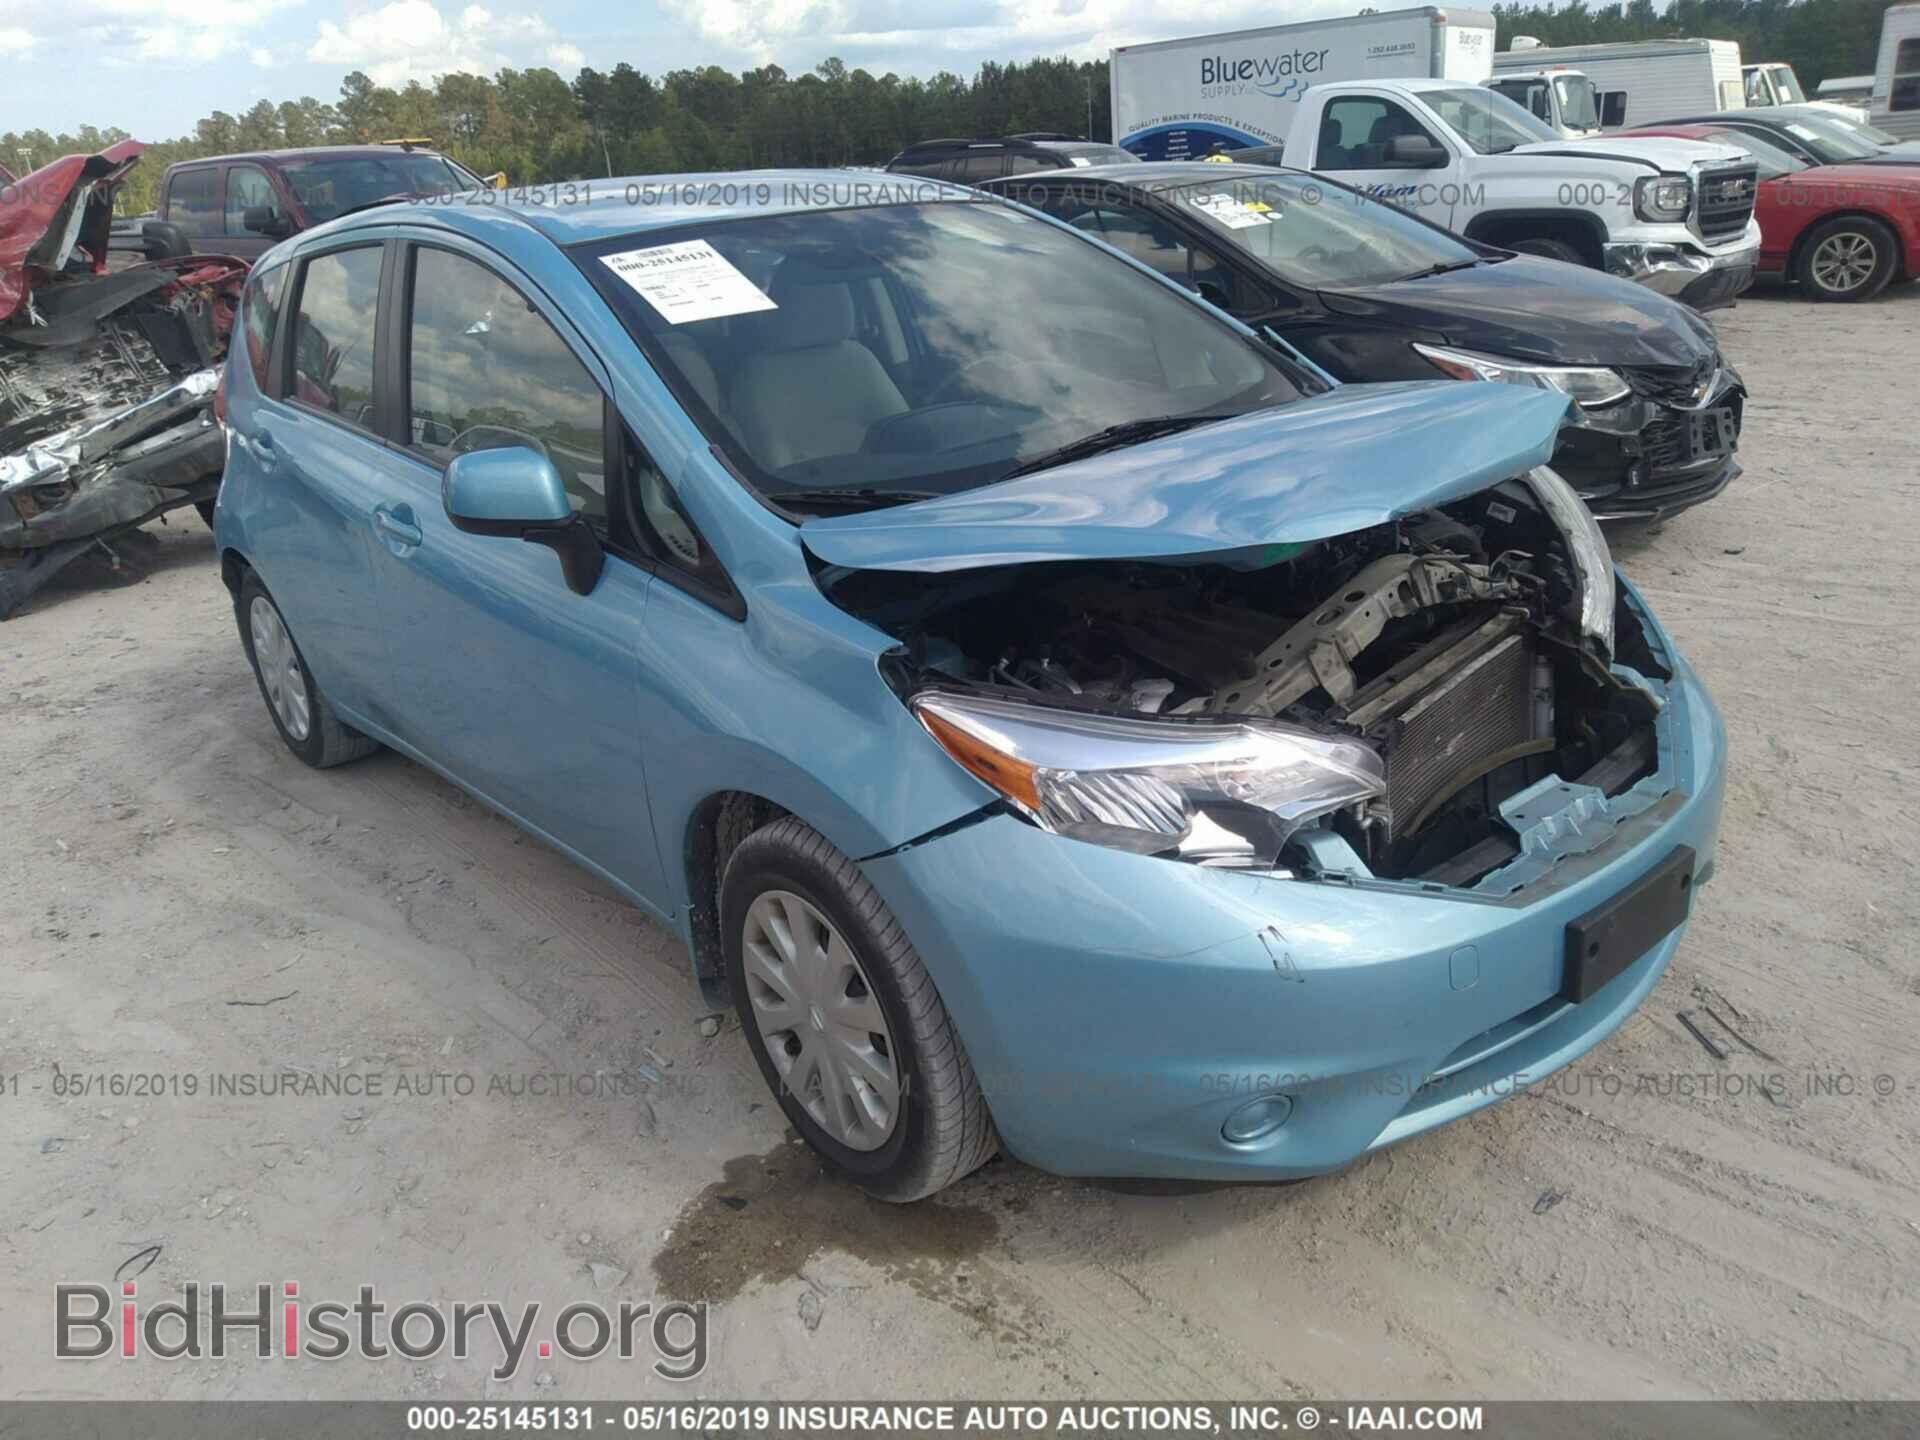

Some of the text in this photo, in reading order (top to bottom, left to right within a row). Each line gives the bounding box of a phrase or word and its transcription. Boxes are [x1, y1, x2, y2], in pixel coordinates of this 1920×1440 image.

[1201, 48, 1330, 85] Bluewater
[1200, 83, 1245, 99] SUPPLY
[1162, 112, 1191, 122] MARINE
[1193, 112, 1233, 125] PRODUCTS
